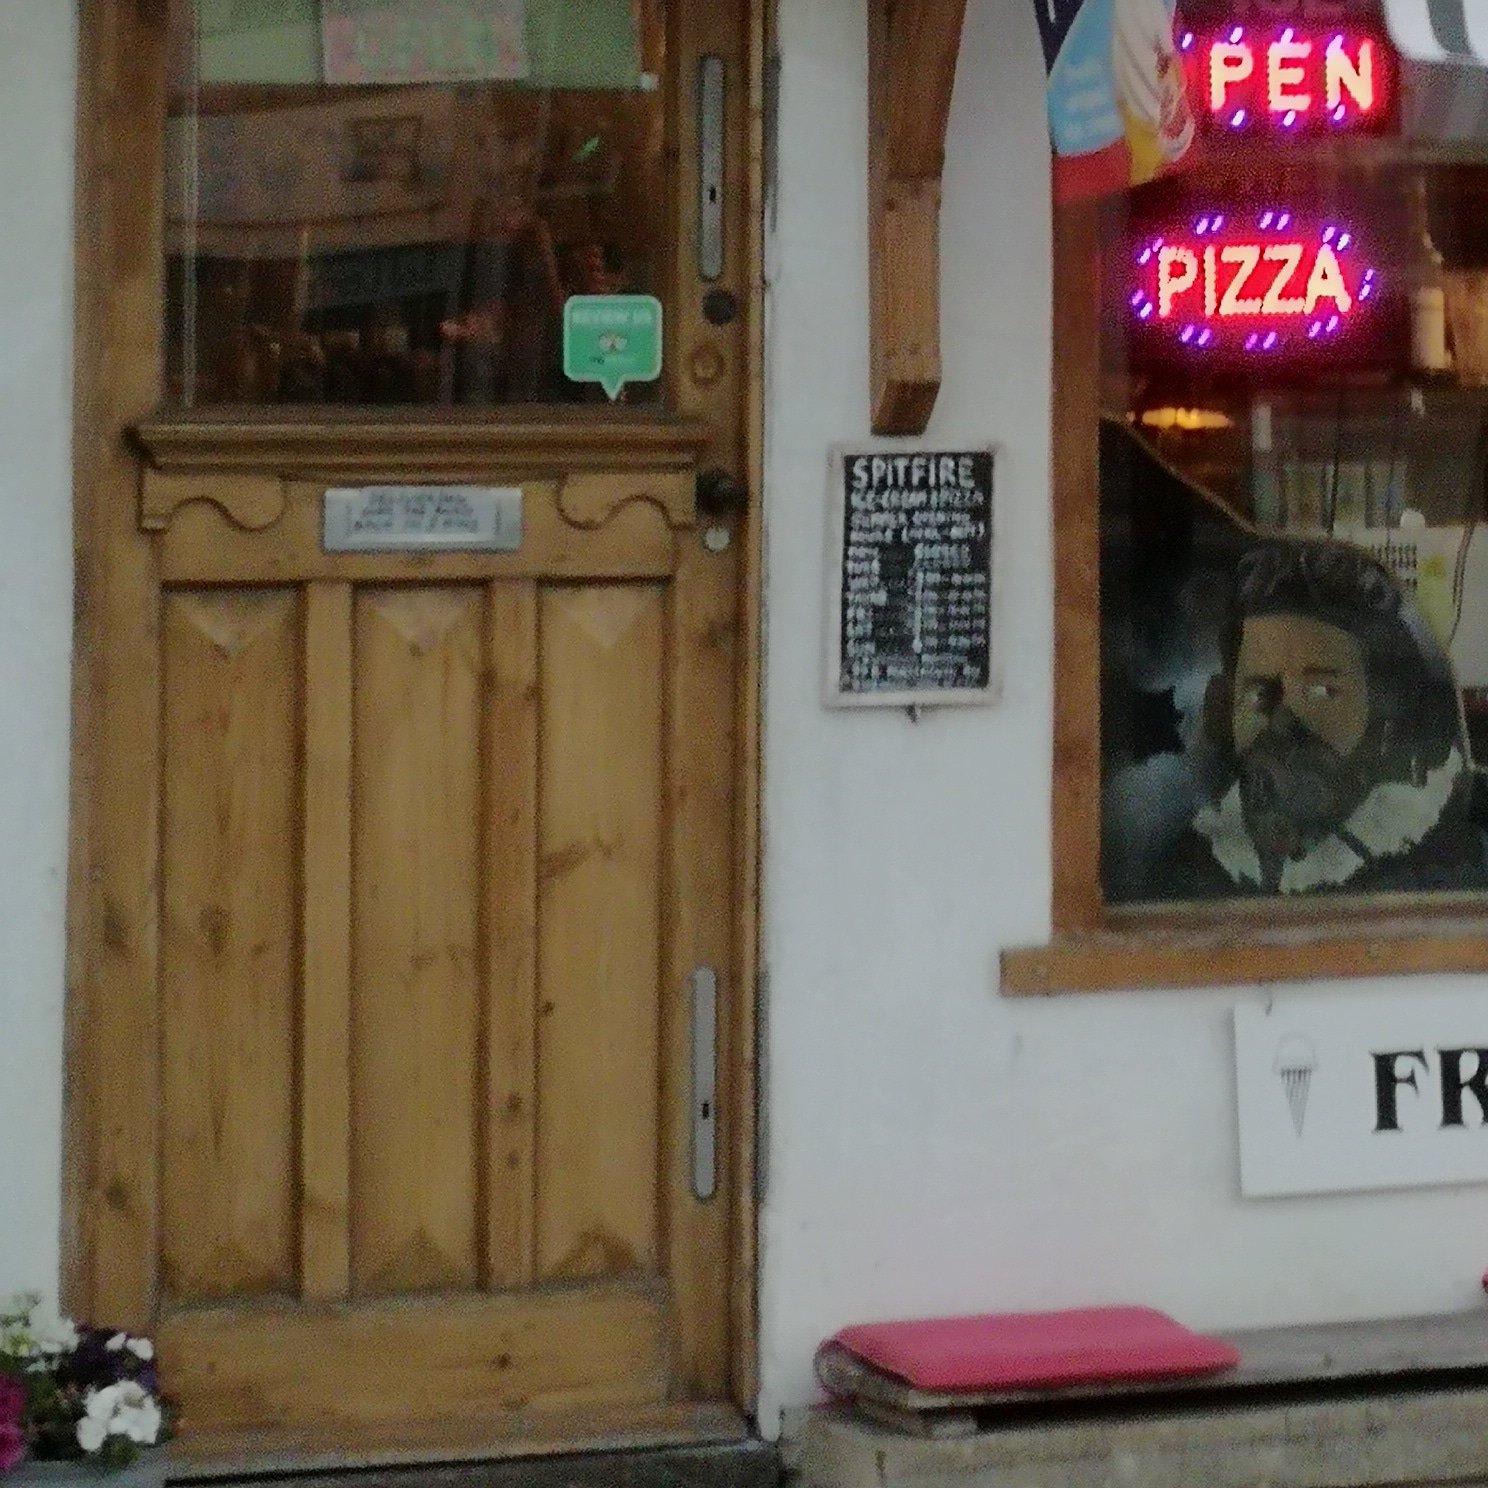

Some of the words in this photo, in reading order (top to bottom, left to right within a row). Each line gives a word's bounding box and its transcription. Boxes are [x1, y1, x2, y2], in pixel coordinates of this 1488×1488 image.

[1209, 38, 1375, 112] PEN
[1157, 243, 1353, 317] PIZZA
[852, 456, 976, 489] SPITFIRE
